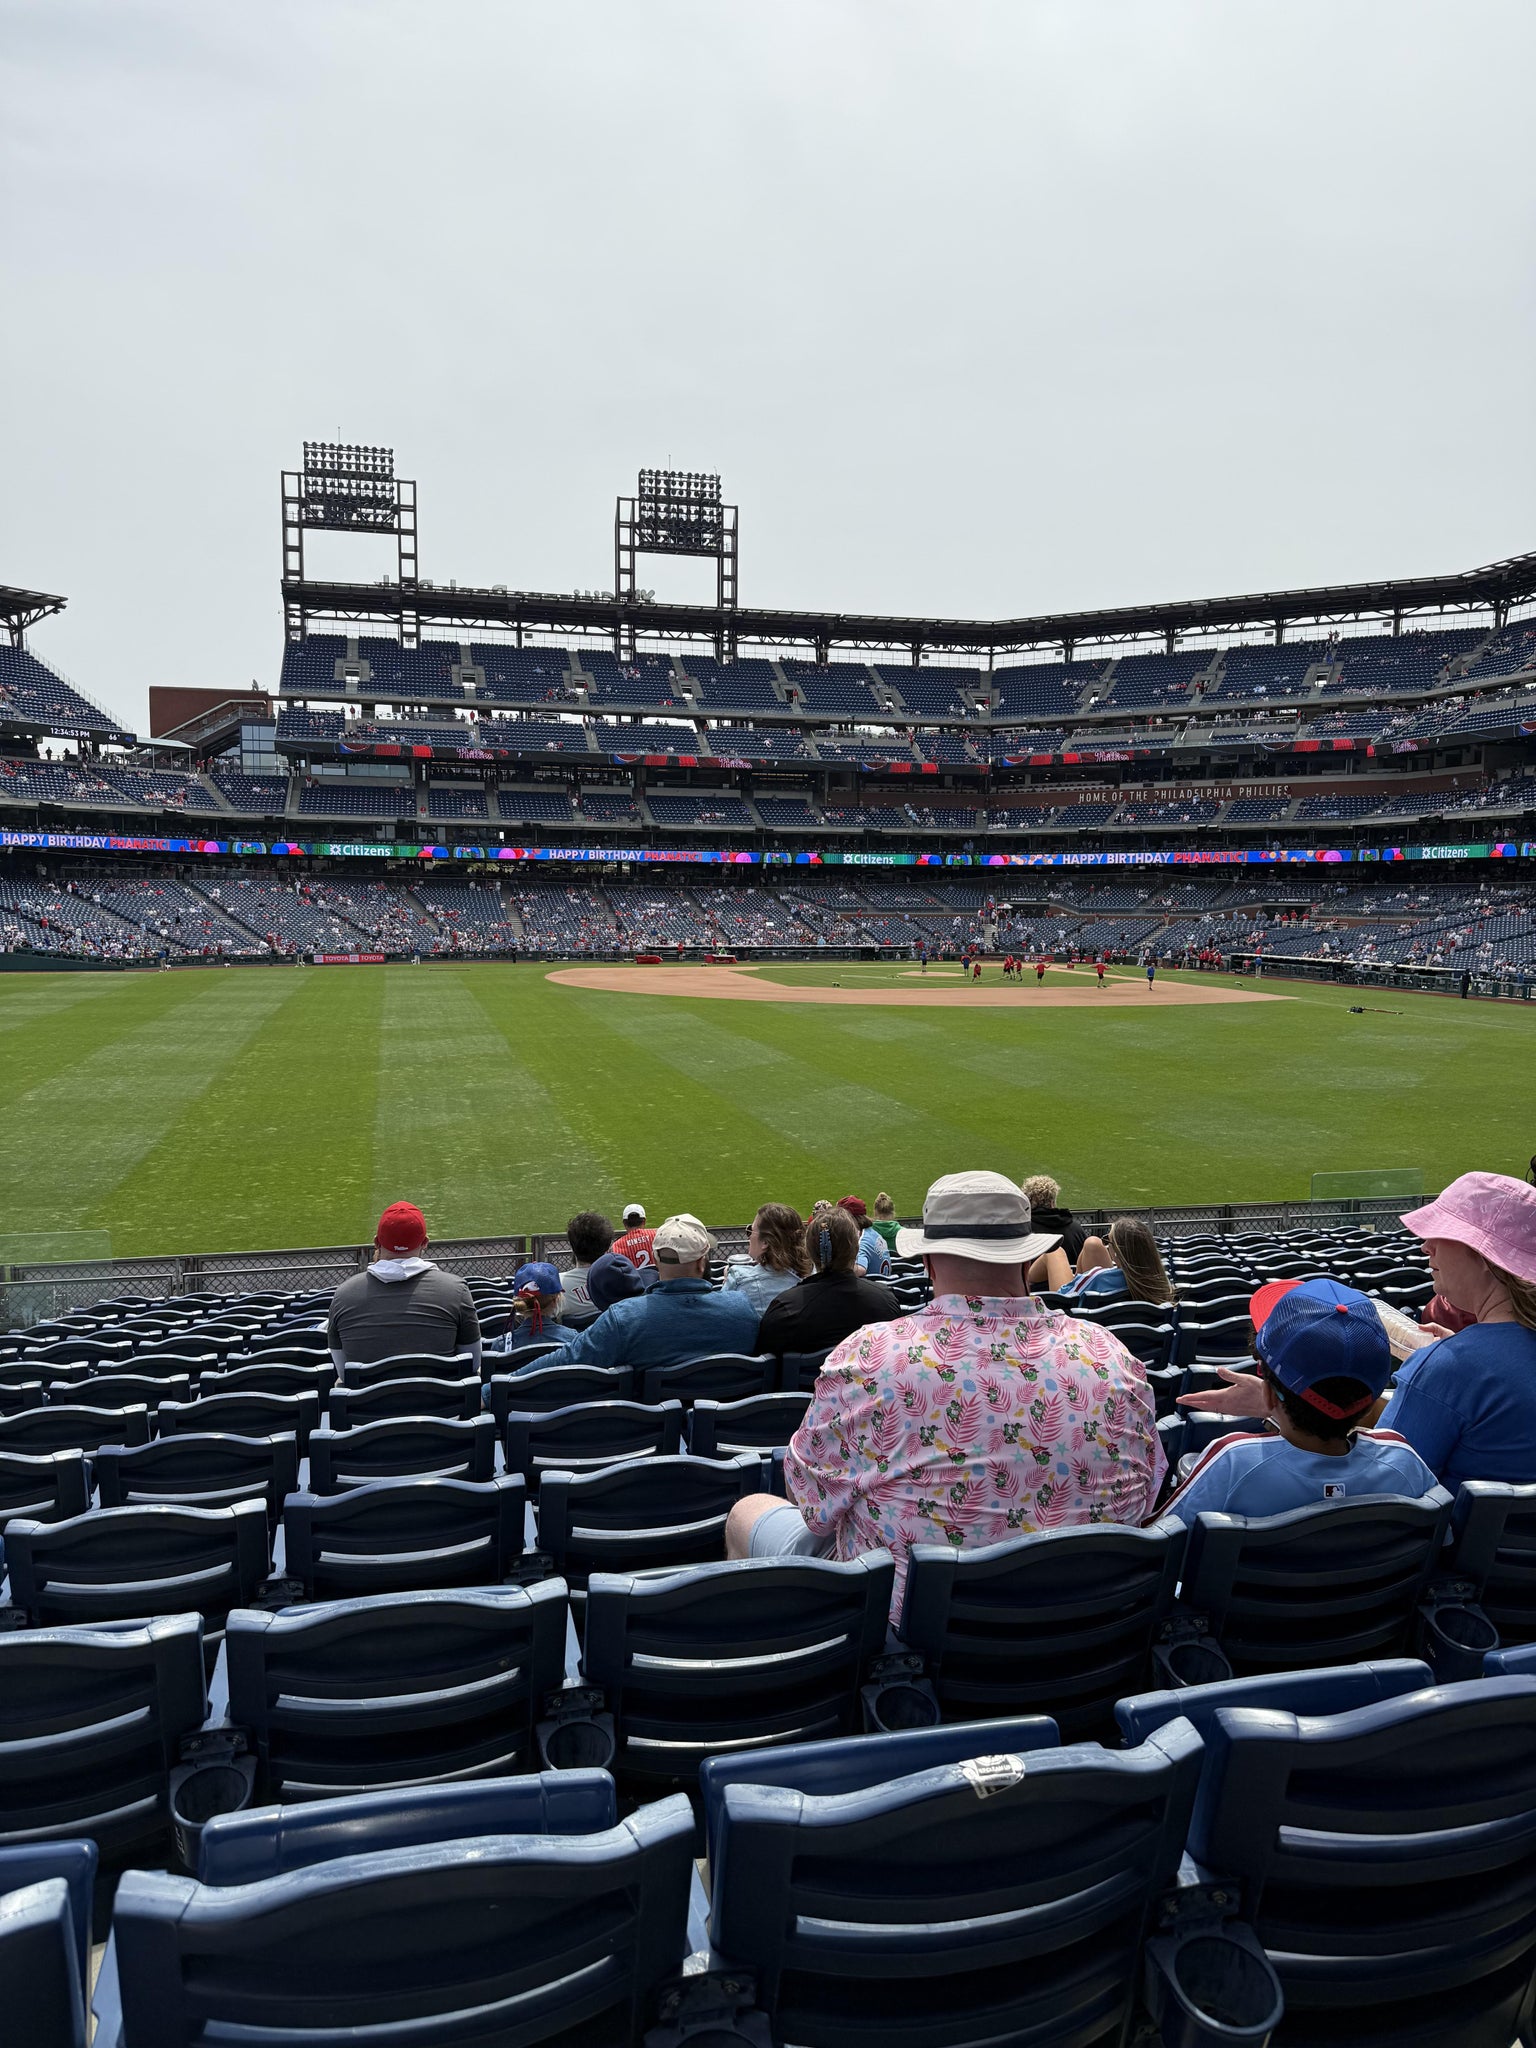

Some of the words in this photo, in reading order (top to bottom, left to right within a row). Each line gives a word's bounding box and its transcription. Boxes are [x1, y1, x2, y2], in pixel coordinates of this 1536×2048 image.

[50, 727, 79, 737] 12:34:53
[80, 730, 90, 738] PM
[1079, 792, 1108, 802] HOME
[1112, 791, 1123, 801] OF
[1130, 790, 1148, 801] THE
[1240, 785, 1289, 797] PHILLIES
[2, 833, 44, 846] HAPPY
[48, 835, 107, 849] BIRTHDAY
[343, 844, 391, 856] Citizens
[549, 849, 586, 860] HAPPY
[588, 849, 642, 861] BIRTHDAY
[1431, 846, 1469, 859] Citizens
[854, 853, 894, 865] Citizens
[1062, 853, 1103, 864] HAPPY
[1106, 852, 1171, 864] BIRTHDAY
[1173, 851, 1249, 863] PHANATIC!
[626, 1235, 651, 1246] KINSEY
